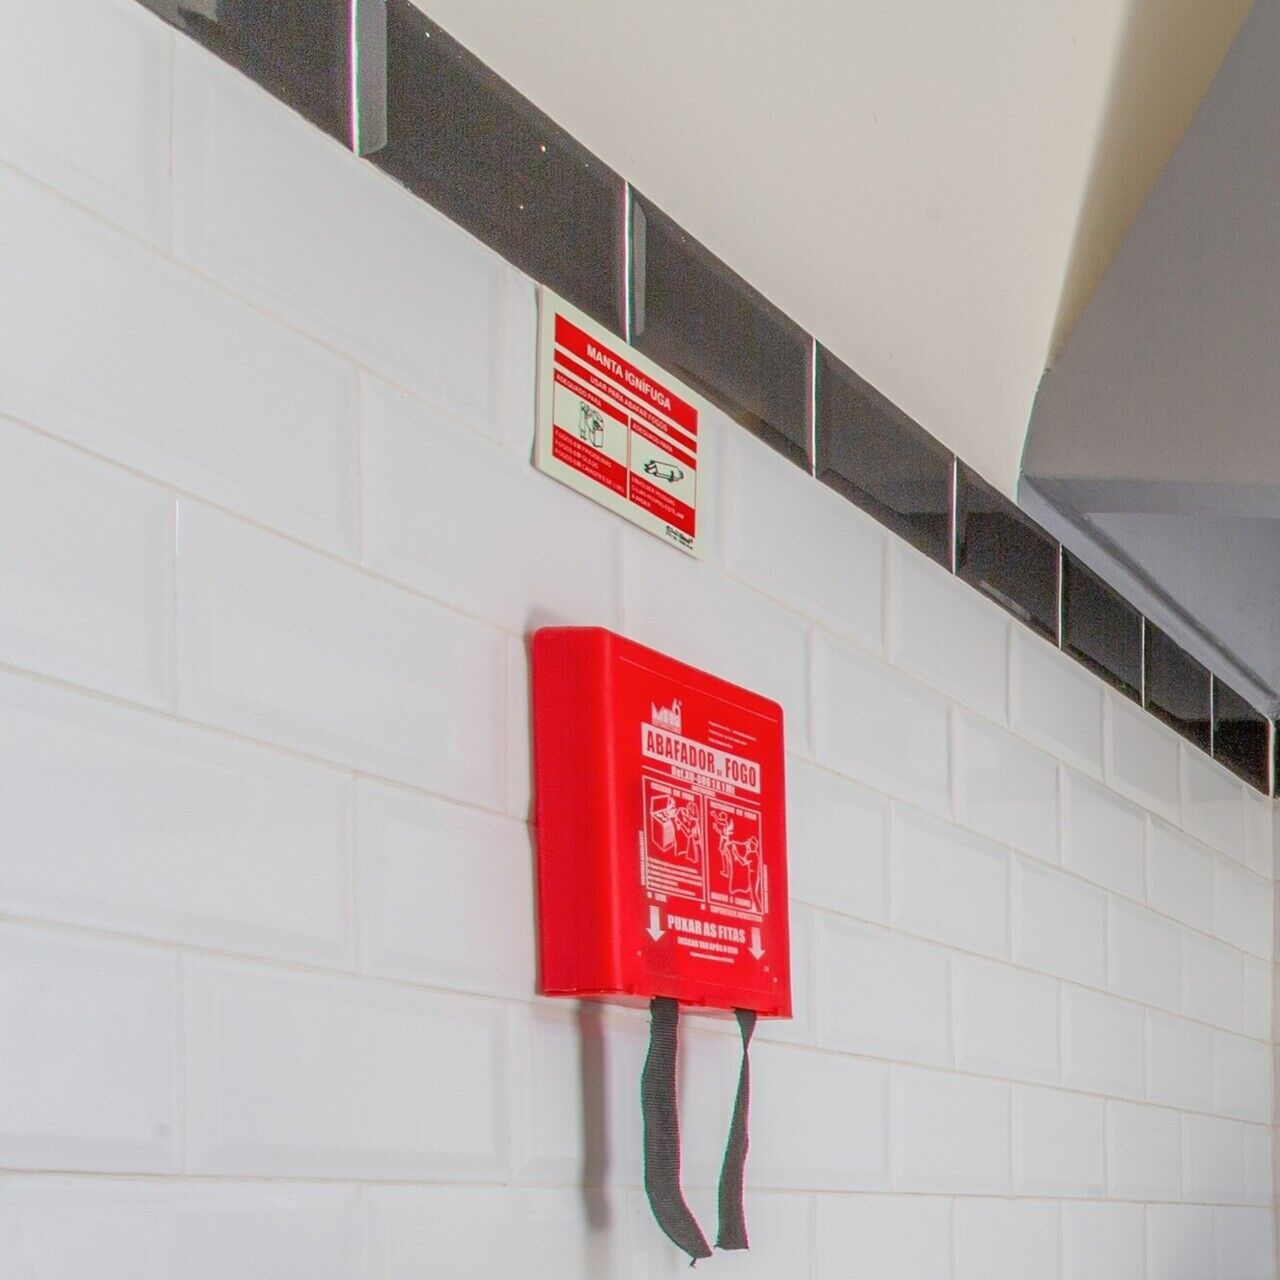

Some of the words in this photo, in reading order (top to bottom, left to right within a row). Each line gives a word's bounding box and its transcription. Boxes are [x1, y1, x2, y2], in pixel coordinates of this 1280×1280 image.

[586, 343, 624, 380] MANTA
[589, 375, 608, 392] USAR
[646, 729, 715, 774] ABAFADOR
[724, 757, 757, 788] FOGO
[667, 914, 702, 936] PUXAR
[703, 921, 717, 938] AS
[718, 925, 746, 944] FITAS
